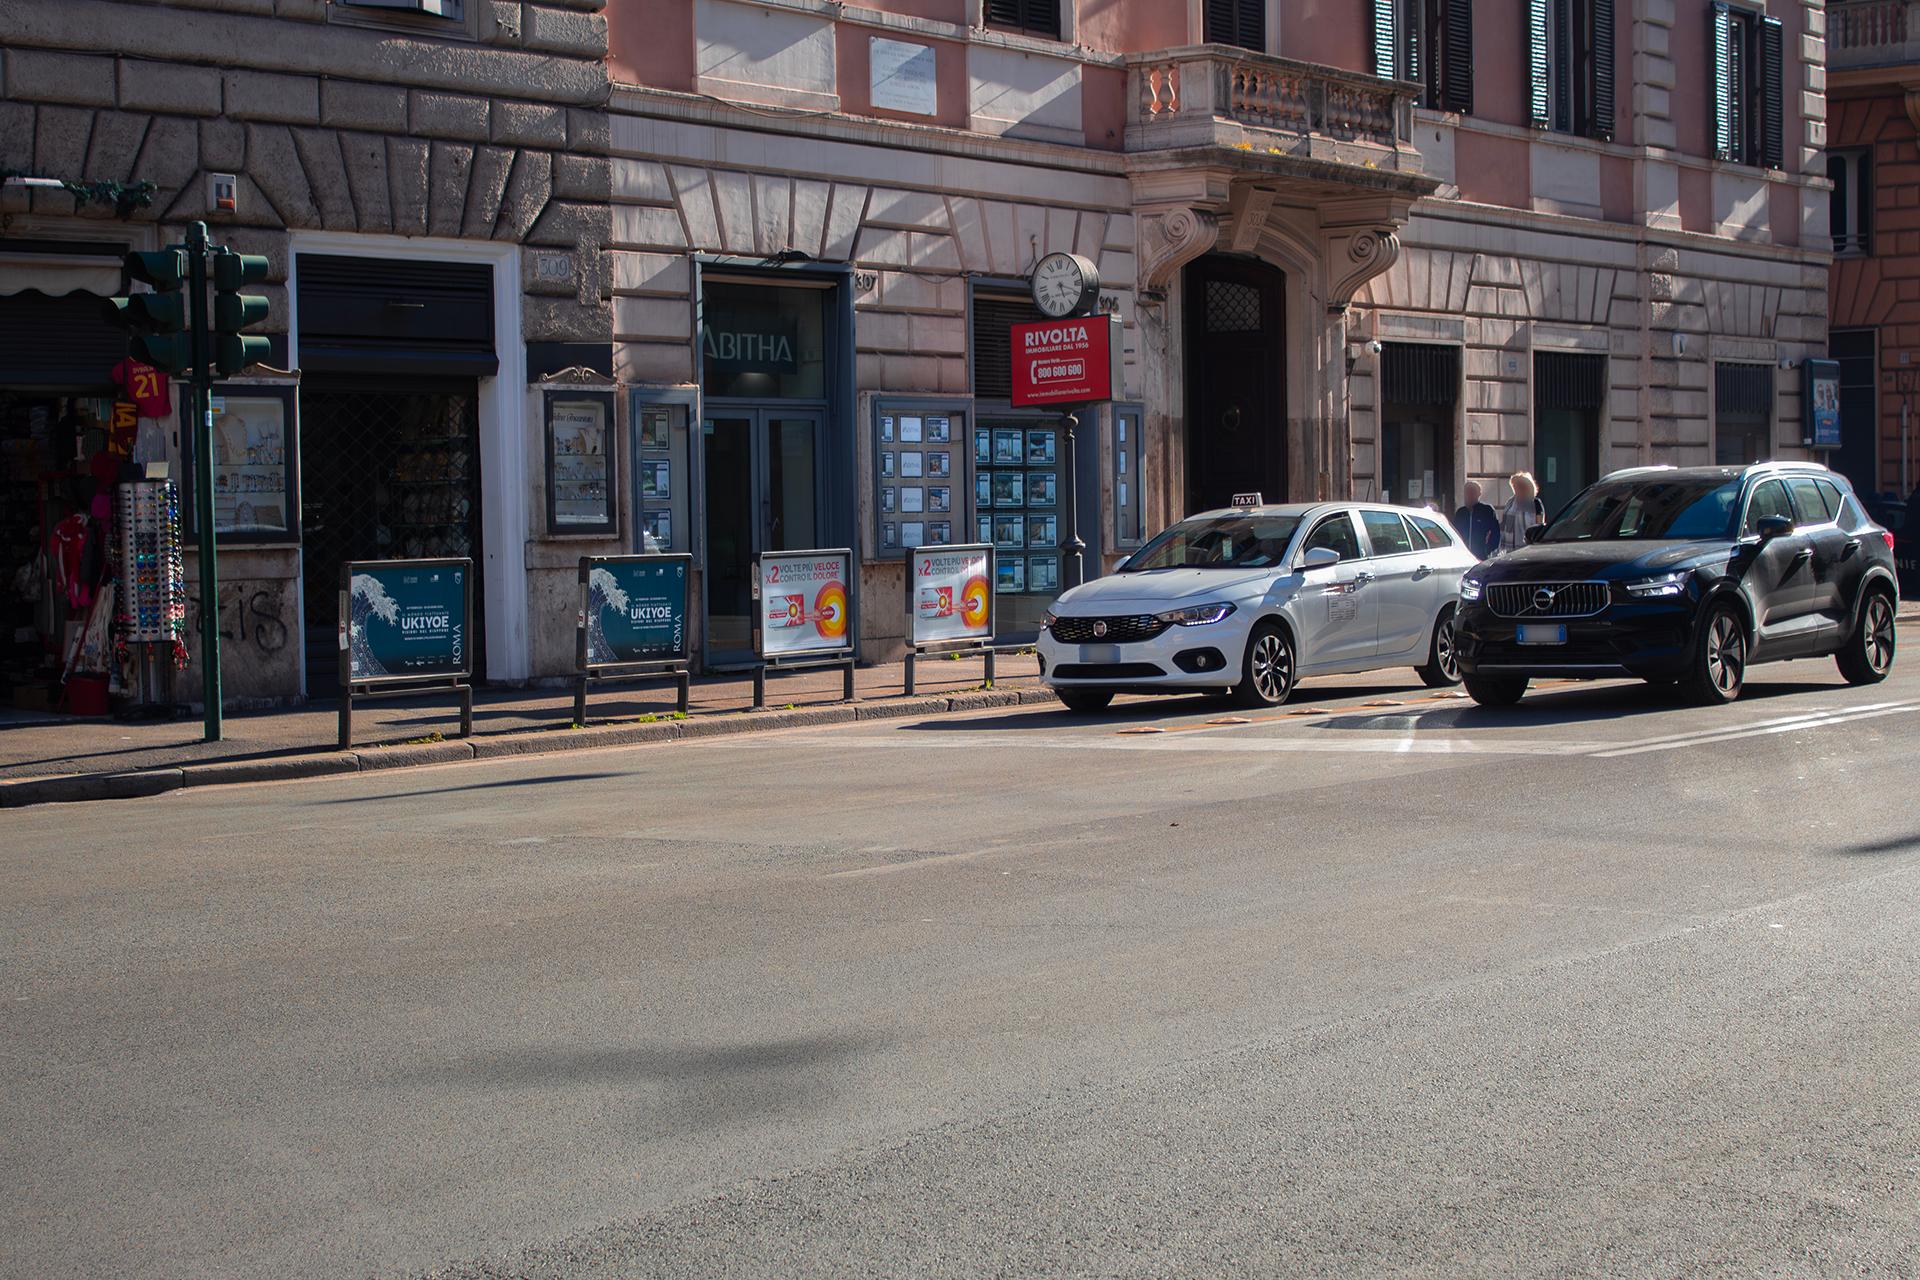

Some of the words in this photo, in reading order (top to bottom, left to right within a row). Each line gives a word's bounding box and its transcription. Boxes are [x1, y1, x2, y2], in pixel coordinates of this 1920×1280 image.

[541, 258, 568, 277] 309
[702, 323, 793, 363] ABITHA
[1025, 326, 1088, 347] RIVOLTA
[134, 373, 158, 398] 21
[1234, 496, 1255, 505] TAXI
[780, 563, 802, 574] VOLTE
[814, 561, 840, 571] VELOCE
[402, 616, 449, 630] UKIYOE
[631, 607, 672, 620] UKIYOE
[673, 614, 682, 652] ROMA
[452, 624, 461, 664] ROMA
